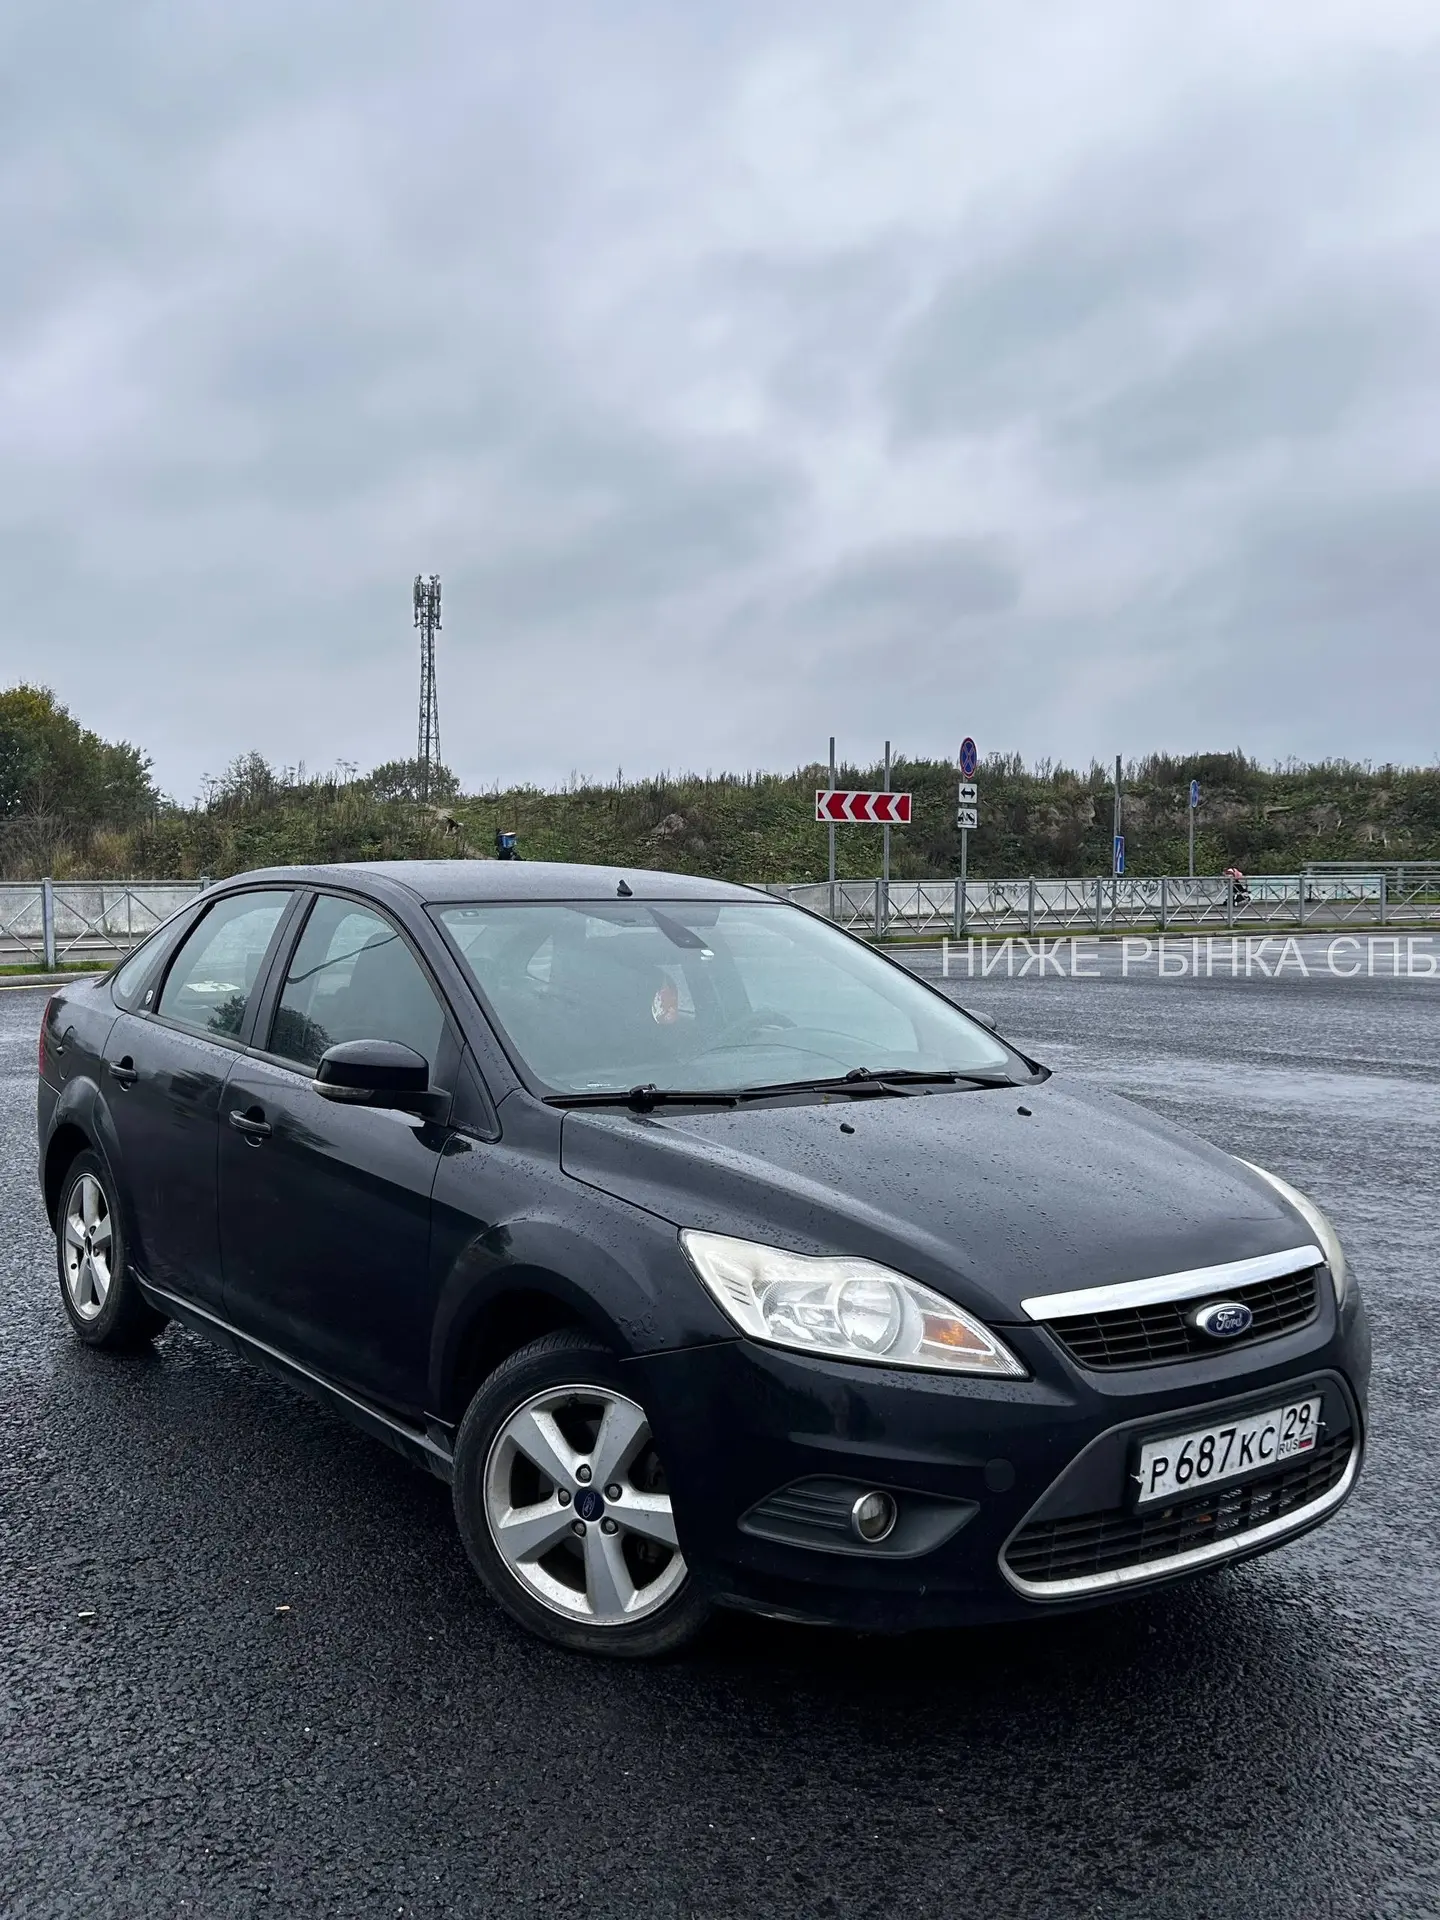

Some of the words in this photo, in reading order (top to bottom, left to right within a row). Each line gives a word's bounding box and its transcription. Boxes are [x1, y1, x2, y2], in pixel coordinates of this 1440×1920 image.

[1216, 1310, 1243, 1331] Ford
[1283, 1403, 1311, 1440] 29
[1279, 1439, 1298, 1453] RUS
